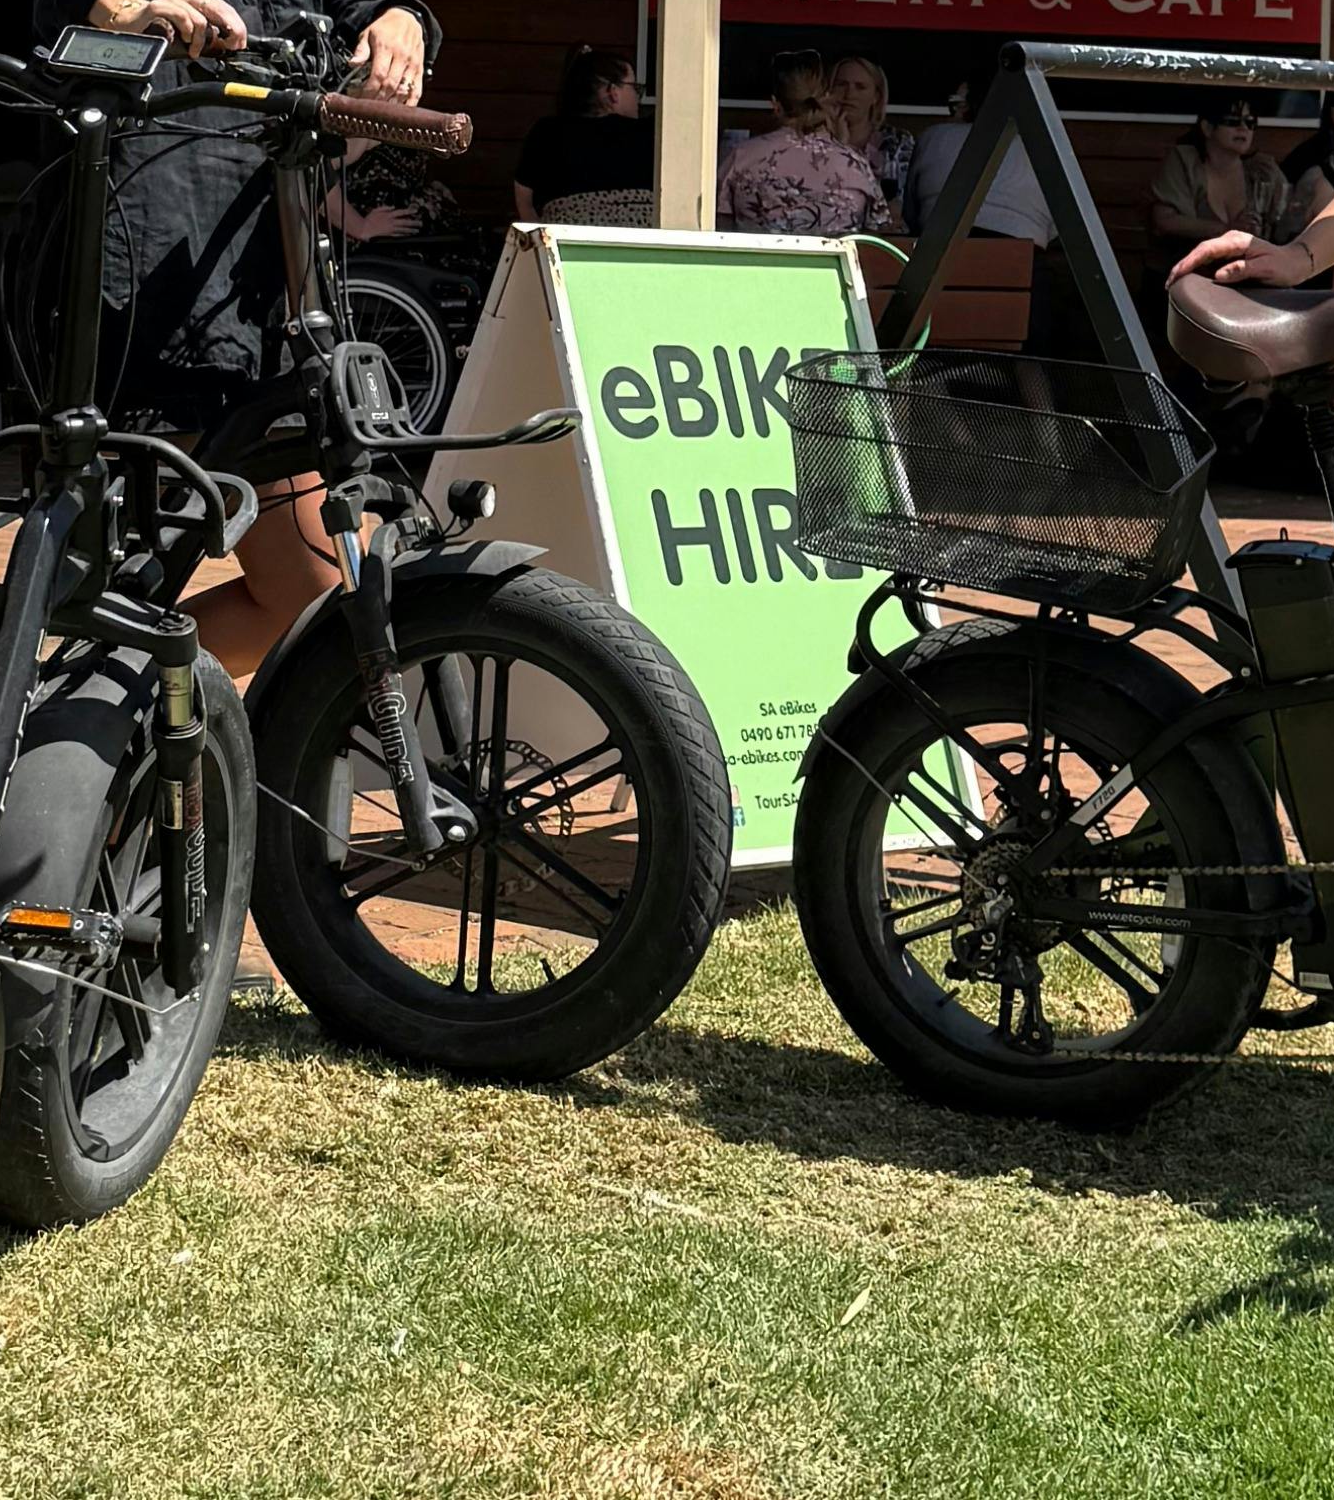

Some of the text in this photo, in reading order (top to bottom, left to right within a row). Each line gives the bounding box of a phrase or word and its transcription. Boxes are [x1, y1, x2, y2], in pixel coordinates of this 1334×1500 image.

[600, 344, 835, 440] eBIK
[759, 700, 818, 717] SA eBikes
[741, 726, 773, 742] 0490
[776, 725, 797, 740] 671
[725, 749, 805, 766] a-ebikes.co
[755, 792, 798, 810] TourSA
[1088, 910, 1192, 928] www.etcycle.com
